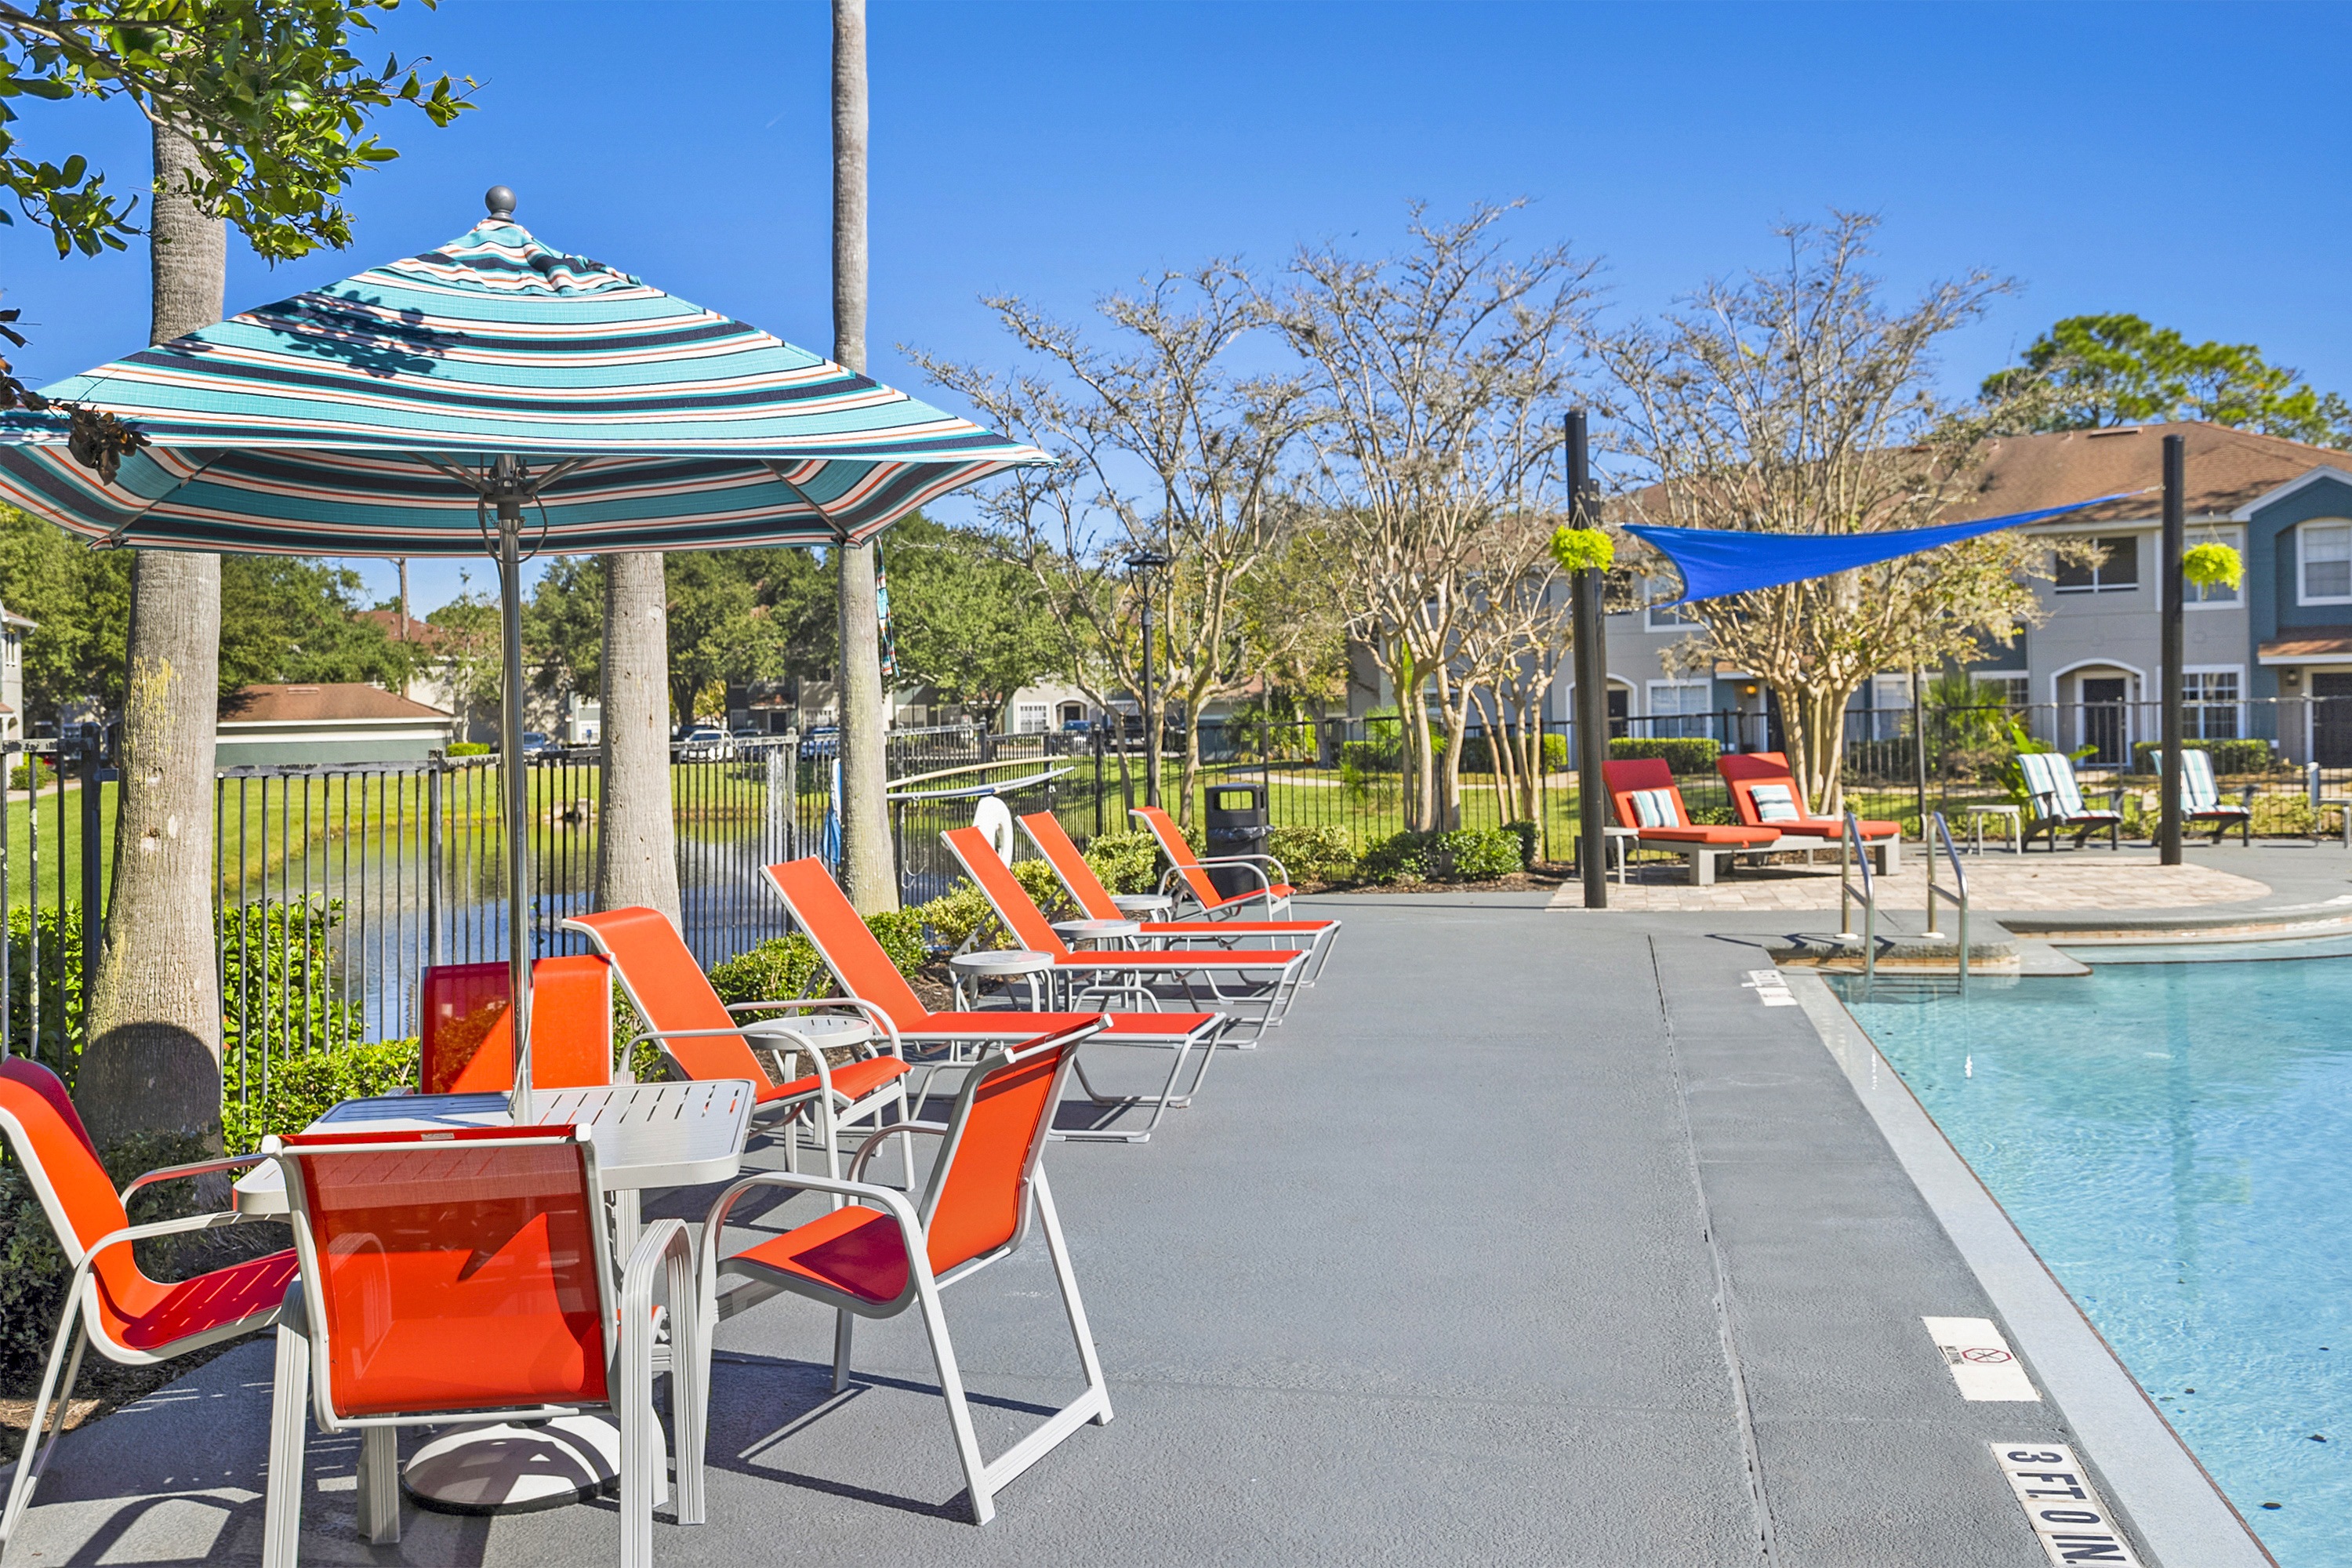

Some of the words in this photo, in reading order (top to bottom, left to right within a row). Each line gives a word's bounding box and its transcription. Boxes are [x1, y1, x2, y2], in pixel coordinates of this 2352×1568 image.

[2007, 1451, 2063, 1463] 3
[2016, 1472, 2087, 1500] FT.
[2051, 1534, 2127, 1564] IN.
